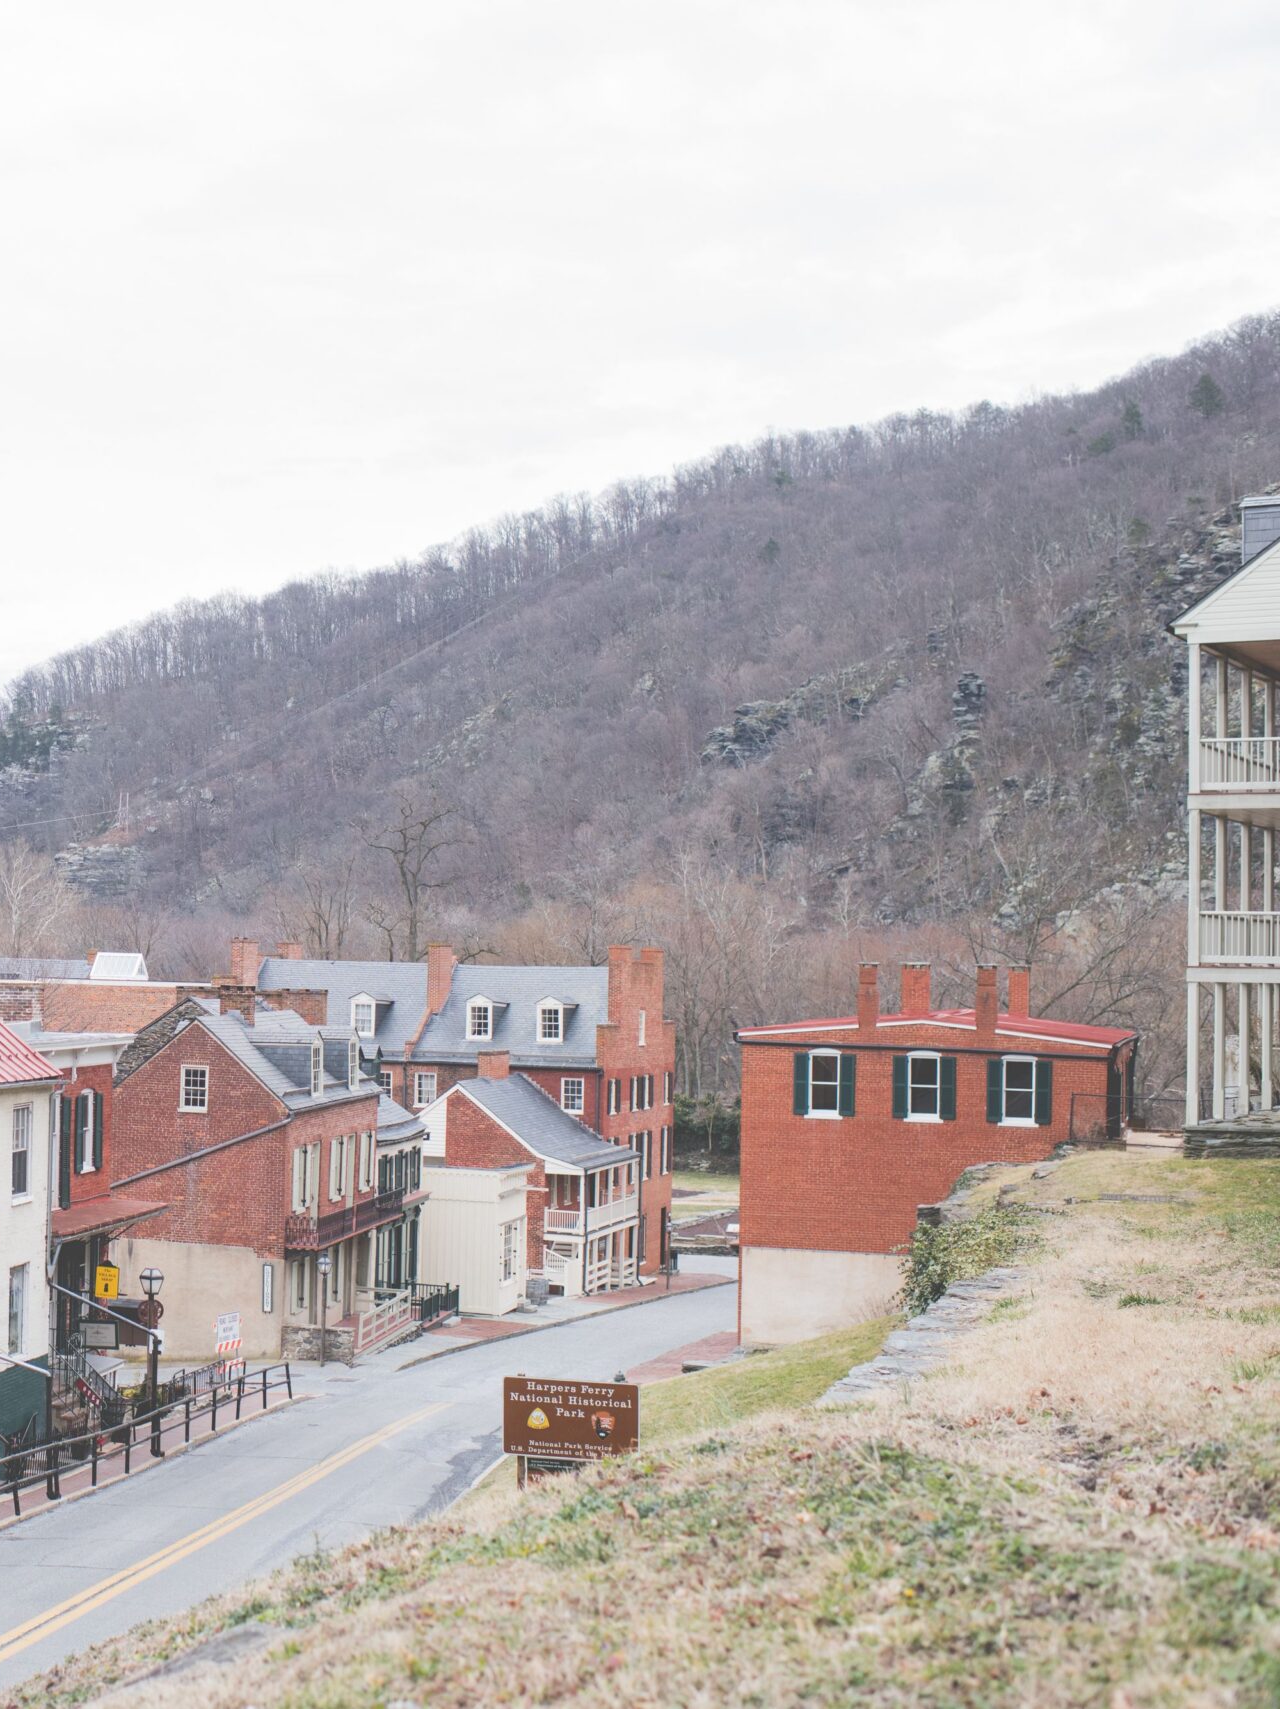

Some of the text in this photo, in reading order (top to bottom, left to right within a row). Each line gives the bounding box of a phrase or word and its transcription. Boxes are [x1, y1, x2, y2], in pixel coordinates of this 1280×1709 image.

[526, 1381, 615, 1397] Harpers Ferry
[510, 1392, 632, 1409] National Historical
[556, 1407, 585, 1418] Park
[528, 1447, 572, 1456] Department
[529, 1440, 613, 1452] National Park Service
